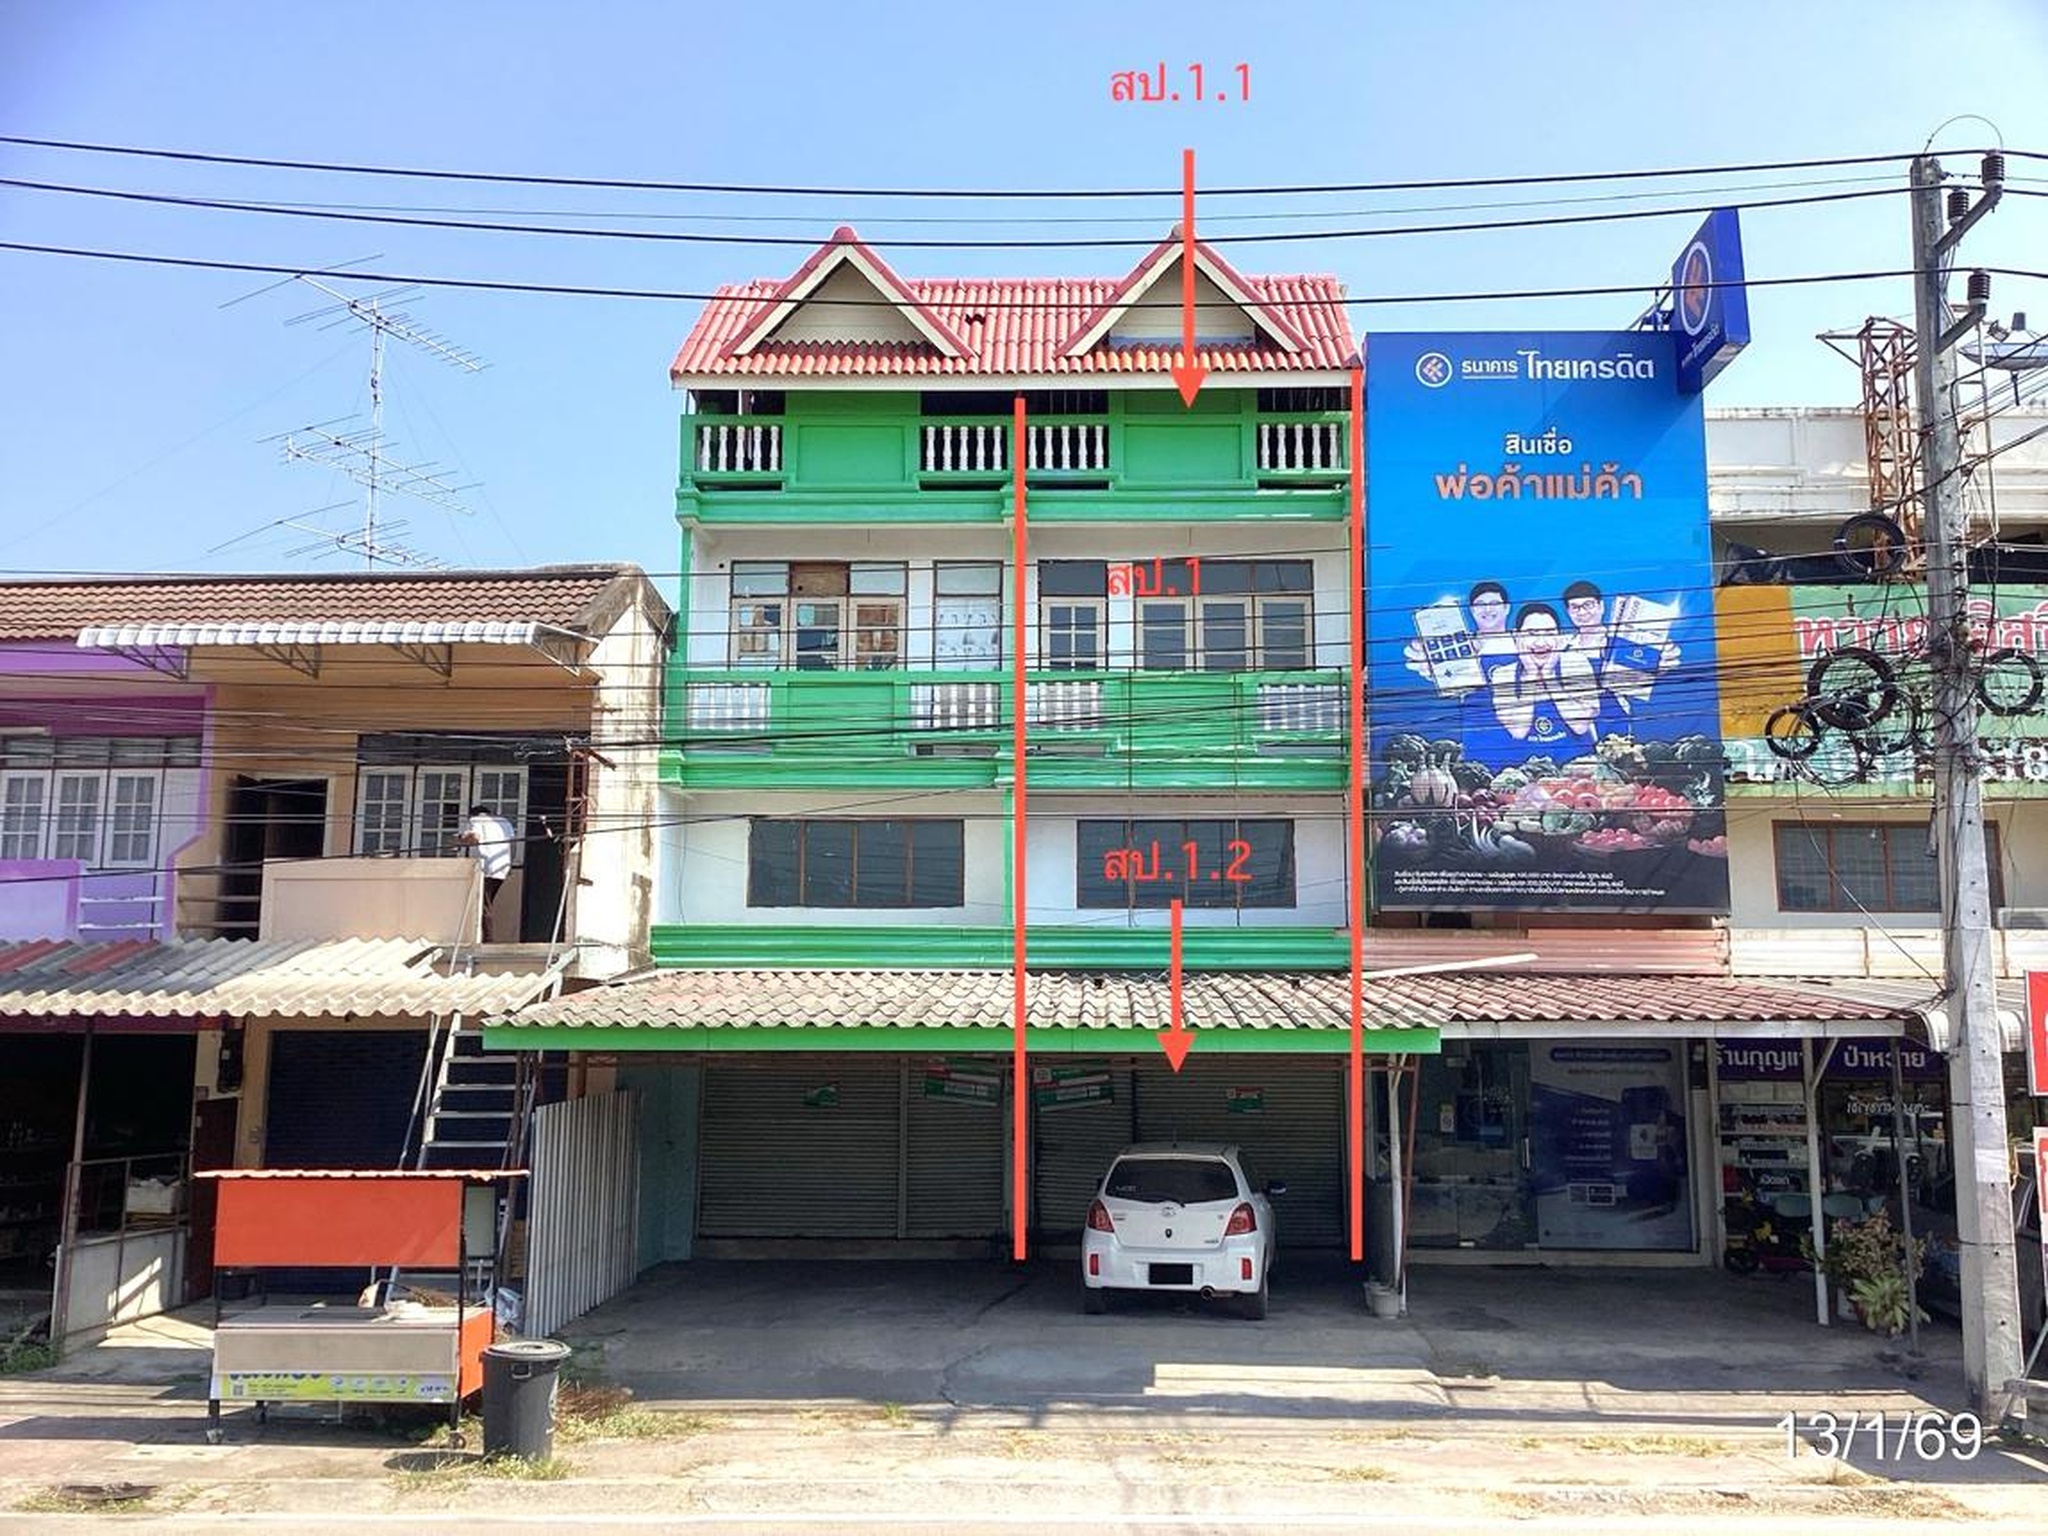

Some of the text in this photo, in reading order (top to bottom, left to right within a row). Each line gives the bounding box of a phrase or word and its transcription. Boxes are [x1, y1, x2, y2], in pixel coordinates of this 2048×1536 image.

[1460, 359, 1519, 374] ธนาคาร
[1517, 349, 1655, 380] ไทยเครดิต
[1504, 425, 1573, 456] สินเชื่อ
[1433, 463, 1644, 500] พ่อค้าแม่ค้า
